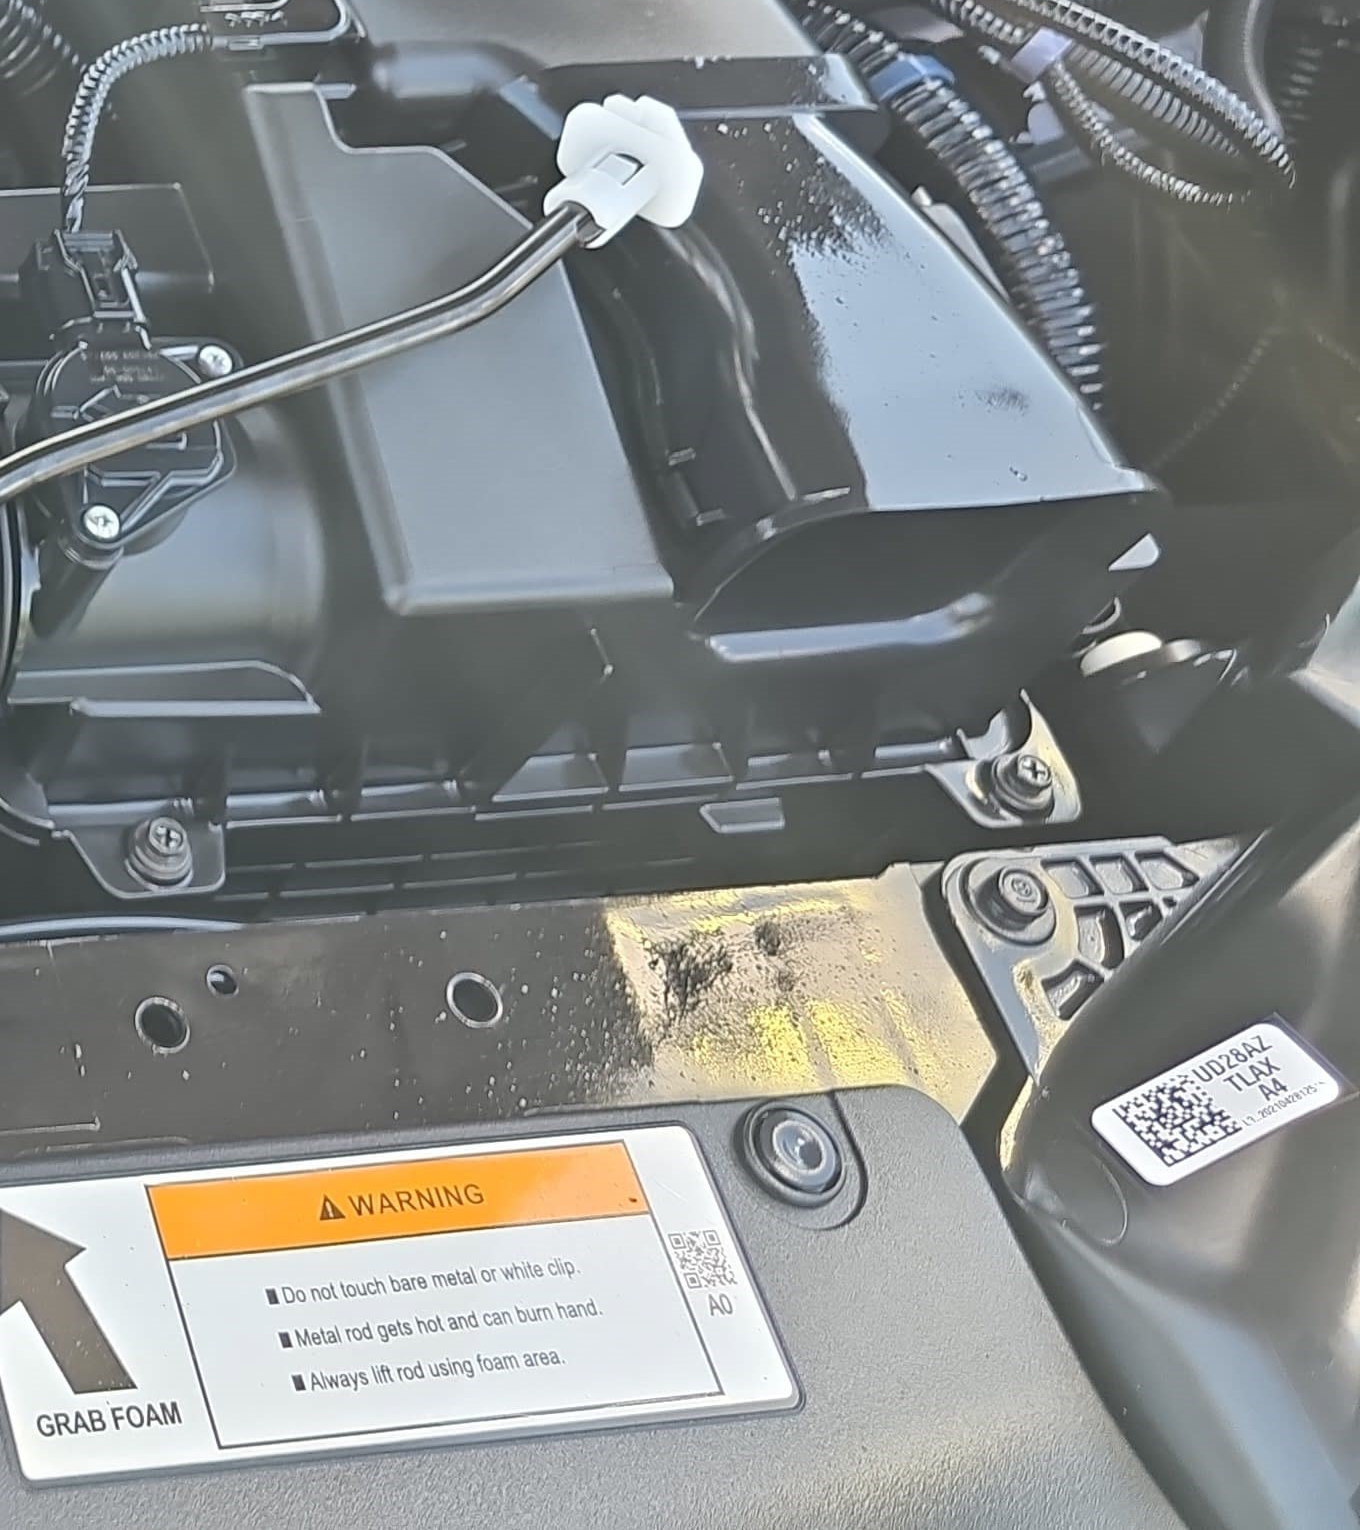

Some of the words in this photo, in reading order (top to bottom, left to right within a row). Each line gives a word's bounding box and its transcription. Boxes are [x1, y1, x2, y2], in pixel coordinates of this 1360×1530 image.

[1191, 1034, 1273, 1083] UD28AZ
[1222, 1056, 1281, 1092] TLAX
[1258, 1077, 1289, 1102] A4
[347, 1183, 485, 1217] WARNING
[281, 1285, 307, 1304] Do
[310, 1282, 339, 1302] not
[340, 1276, 387, 1299] touch
[389, 1274, 429, 1293] bare
[431, 1266, 478, 1288] metal
[480, 1268, 497, 1283] or
[499, 1261, 545, 1281] white
[547, 1257, 581, 1279] clip.
[294, 1325, 342, 1348] Metal
[345, 1321, 374, 1342] rod
[377, 1319, 414, 1343] gets
[414, 1314, 445, 1334] hot
[447, 1310, 480, 1330] and
[482, 1310, 514, 1327] can
[514, 1306, 555, 1323] burn
[555, 1298, 604, 1319] hand.
[310, 1371, 370, 1392] Always
[370, 1364, 395, 1385] lift
[396, 1360, 426, 1382] rod
[428, 1357, 476, 1379] using
[476, 1353, 521, 1373] foam
[522, 1349, 566, 1368] area.
[36, 1409, 107, 1437] GRAB
[110, 1401, 183, 1430] FOAM
